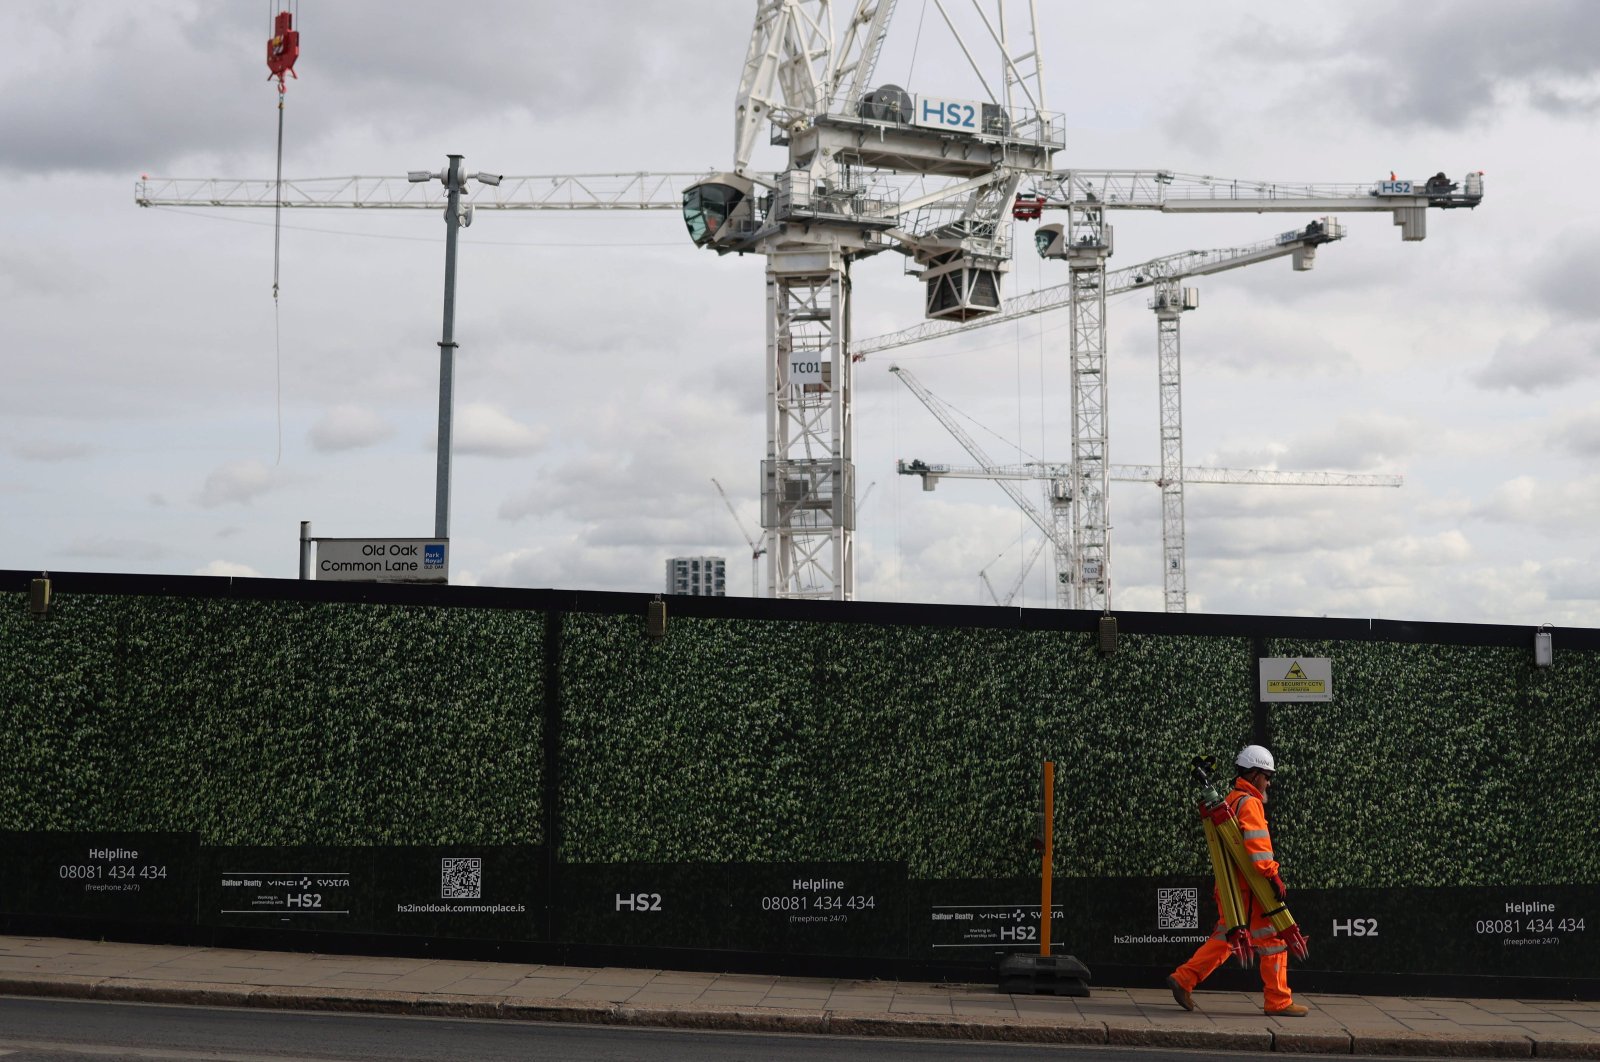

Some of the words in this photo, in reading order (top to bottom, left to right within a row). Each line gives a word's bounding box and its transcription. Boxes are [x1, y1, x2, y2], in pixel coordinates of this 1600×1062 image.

[923, 99, 975, 128] HS2
[1382, 182, 1410, 193] HS2
[791, 362, 820, 374] TC01
[362, 544, 385, 556] Old
[389, 544, 418, 556] Oak
[320, 559, 382, 572] Common
[385, 559, 418, 572] Lane
[89, 848, 139, 861] Helpline
[59, 865, 103, 879] 08081
[108, 865, 136, 879] 434
[139, 865, 168, 879] 434
[85, 883, 122, 892] (freephone
[122, 883, 140, 892] 24/7)
[221, 879, 243, 887] Balfour
[243, 879, 262, 888] Beatty
[317, 879, 350, 887] SYSTRA
[792, 879, 845, 893] Helpline
[287, 893, 322, 908] HS2
[615, 893, 662, 912] HS2
[761, 896, 807, 910] 08081
[813, 896, 843, 910] 434
[846, 895, 876, 910] 434
[397, 903, 526, 914] hs2inoldoak.commonplace.is
[1505, 902, 1555, 916] Helpline
[789, 914, 828, 924] (freephone
[829, 914, 848, 923] 24/7)
[954, 913, 974, 921] Beatty
[1332, 918, 1379, 937] HS2
[1476, 919, 1520, 934] 08081
[1525, 918, 1554, 933] 434
[1557, 917, 1586, 932] 434
[1000, 926, 1037, 941] HS2
[1503, 937, 1541, 947] (freephone
[1542, 937, 1560, 946] 24/7)
